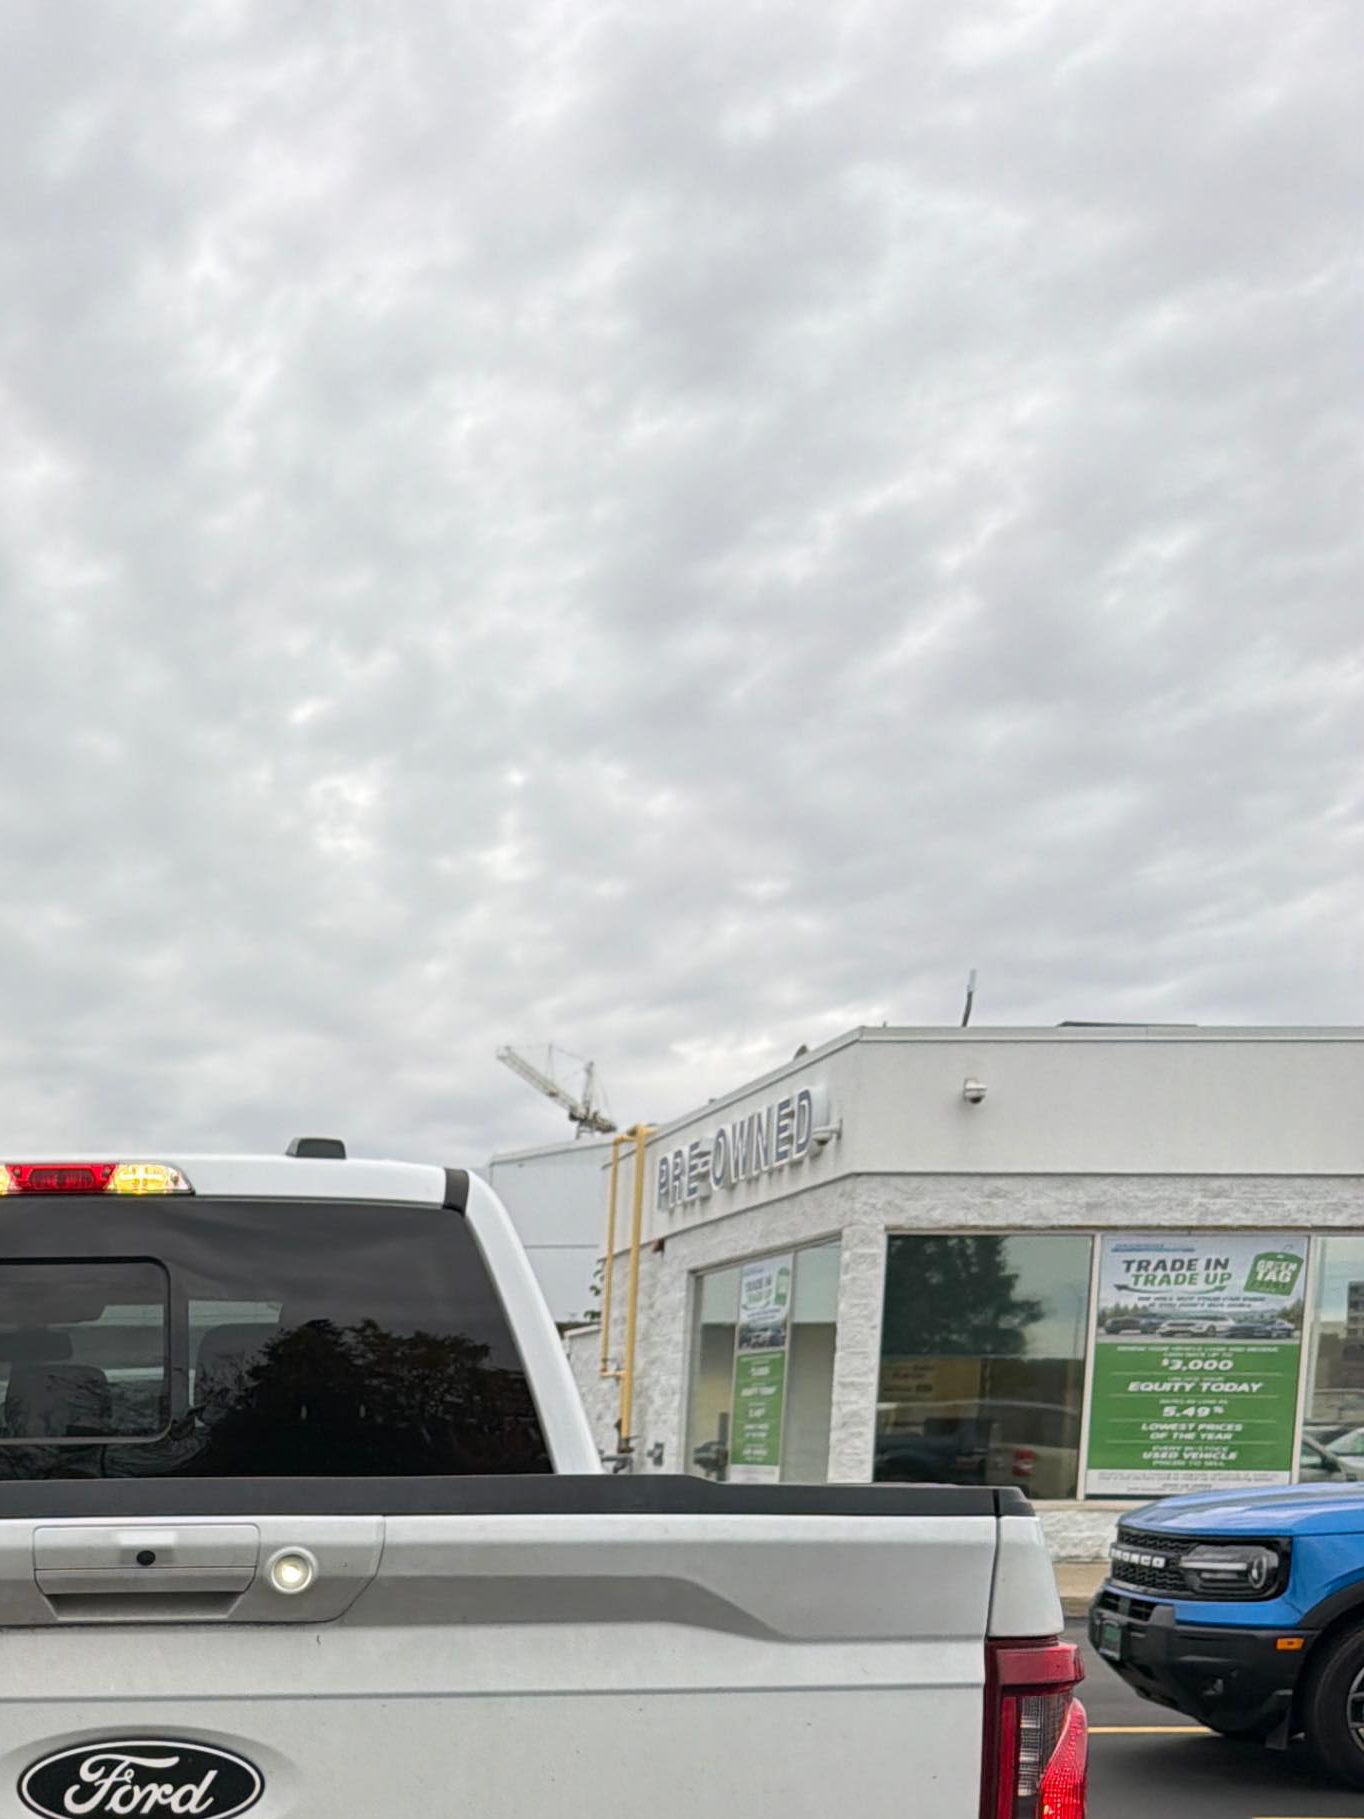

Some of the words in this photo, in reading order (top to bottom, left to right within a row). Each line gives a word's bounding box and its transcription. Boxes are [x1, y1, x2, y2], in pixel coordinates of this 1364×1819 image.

[657, 1088, 814, 1211] PRE-OWNED
[1123, 1258, 1199, 1273] TRADE
[1204, 1257, 1230, 1271] IN
[1131, 1273, 1198, 1287] TRADE
[1205, 1272, 1232, 1285] UP
[1255, 1270, 1294, 1283] TAG
[1128, 1381, 1196, 1392] EQUITY
[1200, 1381, 1264, 1393] TODAY
[1141, 1422, 1196, 1431] LOWEST
[1198, 1423, 1243, 1432] PRICES
[1149, 1432, 1167, 1440] OF
[1172, 1432, 1196, 1440] THE
[1200, 1432, 1233, 1440] YEAR
[1142, 1451, 1180, 1460] USED
[1183, 1451, 1239, 1461] VEHICLE
[63, 1753, 219, 1815] Ford
